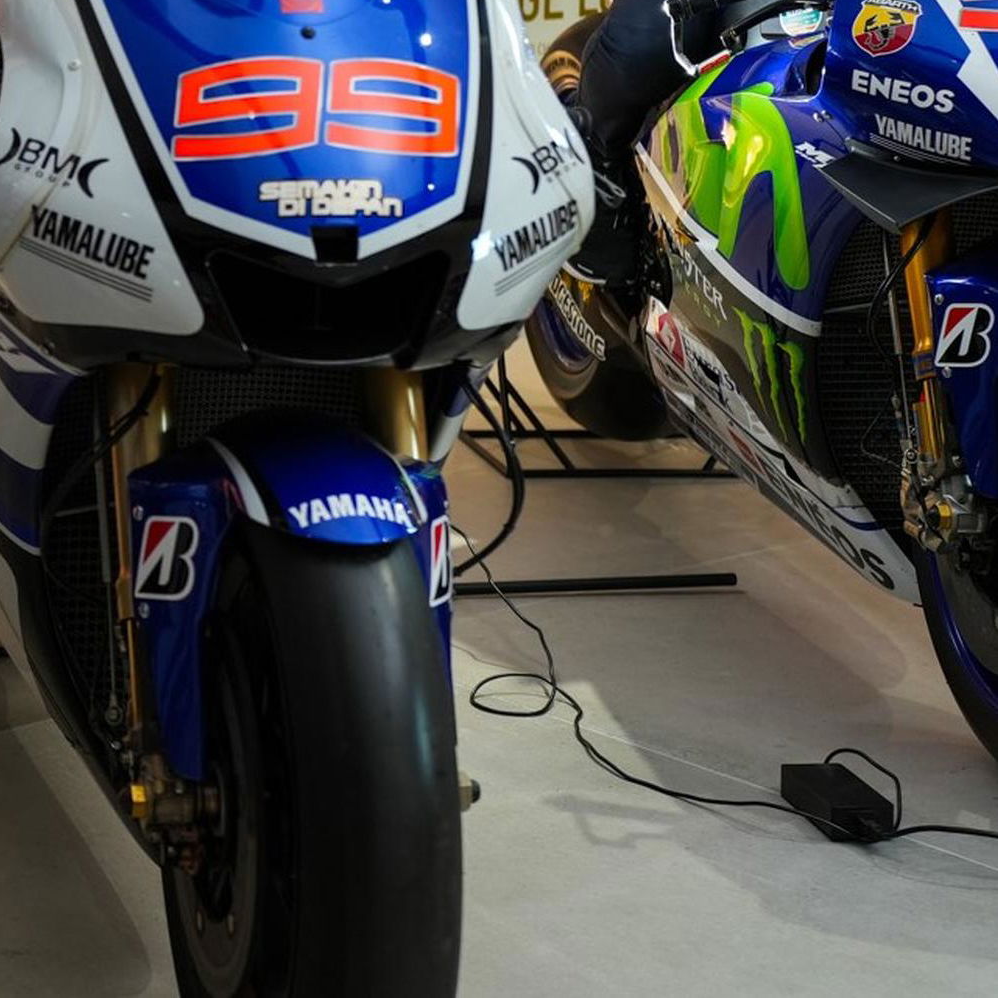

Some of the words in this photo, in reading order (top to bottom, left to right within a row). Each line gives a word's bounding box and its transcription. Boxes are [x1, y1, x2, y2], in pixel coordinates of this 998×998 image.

[172, 55, 461, 163] 99
[851, 68, 955, 114] ENEOS
[874, 113, 973, 162] YAMALUBE
[28, 204, 155, 281] YAMALUBE
[493, 199, 579, 273] YAMALUBE
[288, 493, 415, 532] YAMAHA
